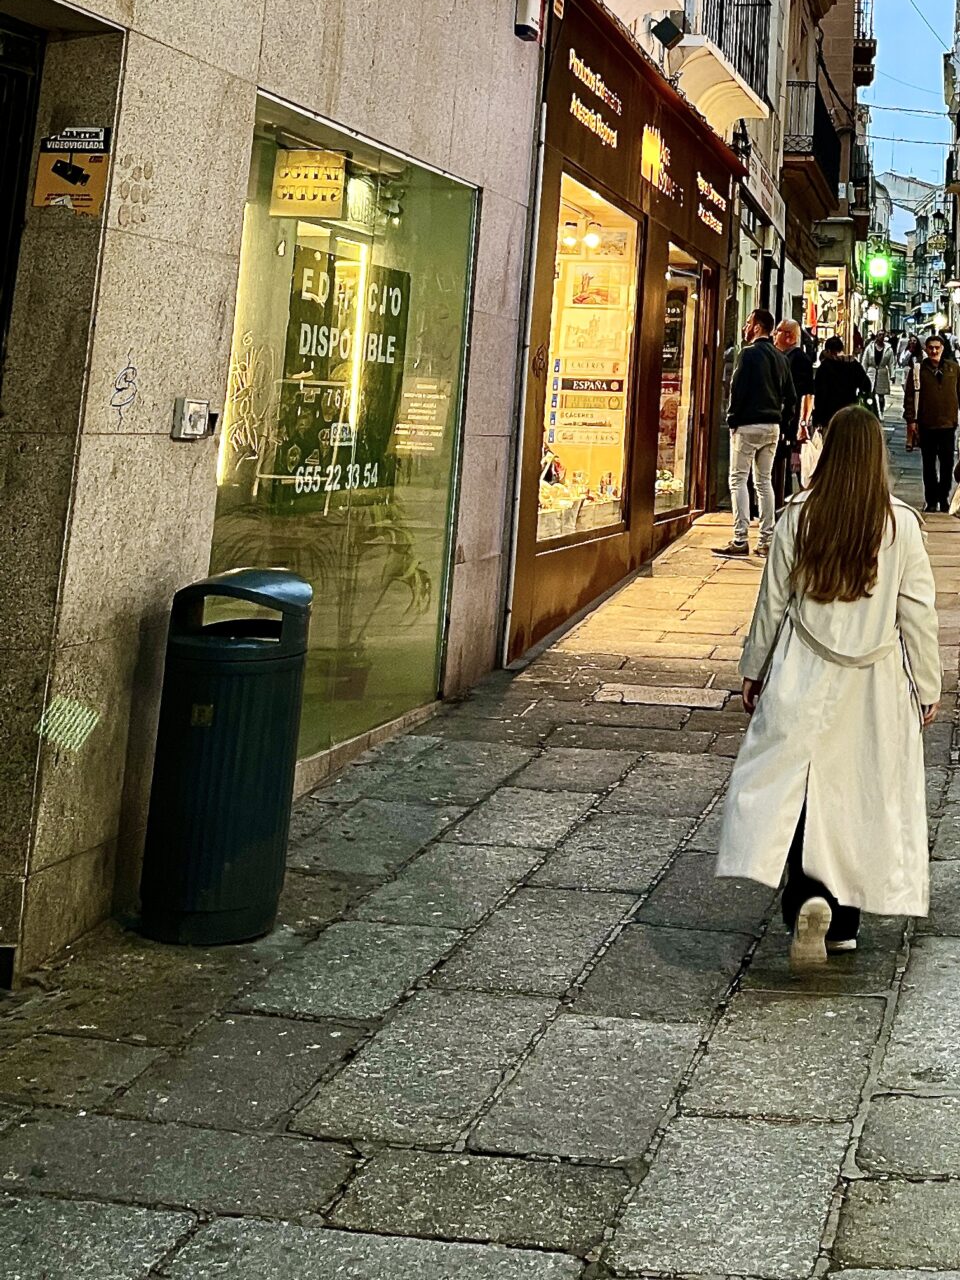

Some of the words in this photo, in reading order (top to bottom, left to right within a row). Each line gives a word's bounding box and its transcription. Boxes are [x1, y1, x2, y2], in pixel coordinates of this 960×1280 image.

[46, 141, 104, 149] VIDEOVIGILADA
[301, 268, 402, 316] EDIFCIO
[299, 323, 396, 364] DISPOIBLE
[573, 380, 607, 390] ESPAÑA
[295, 465, 322, 494] 655
[324, 465, 342, 491] 22
[345, 464, 360, 489] 33
[363, 462, 378, 488] 54
